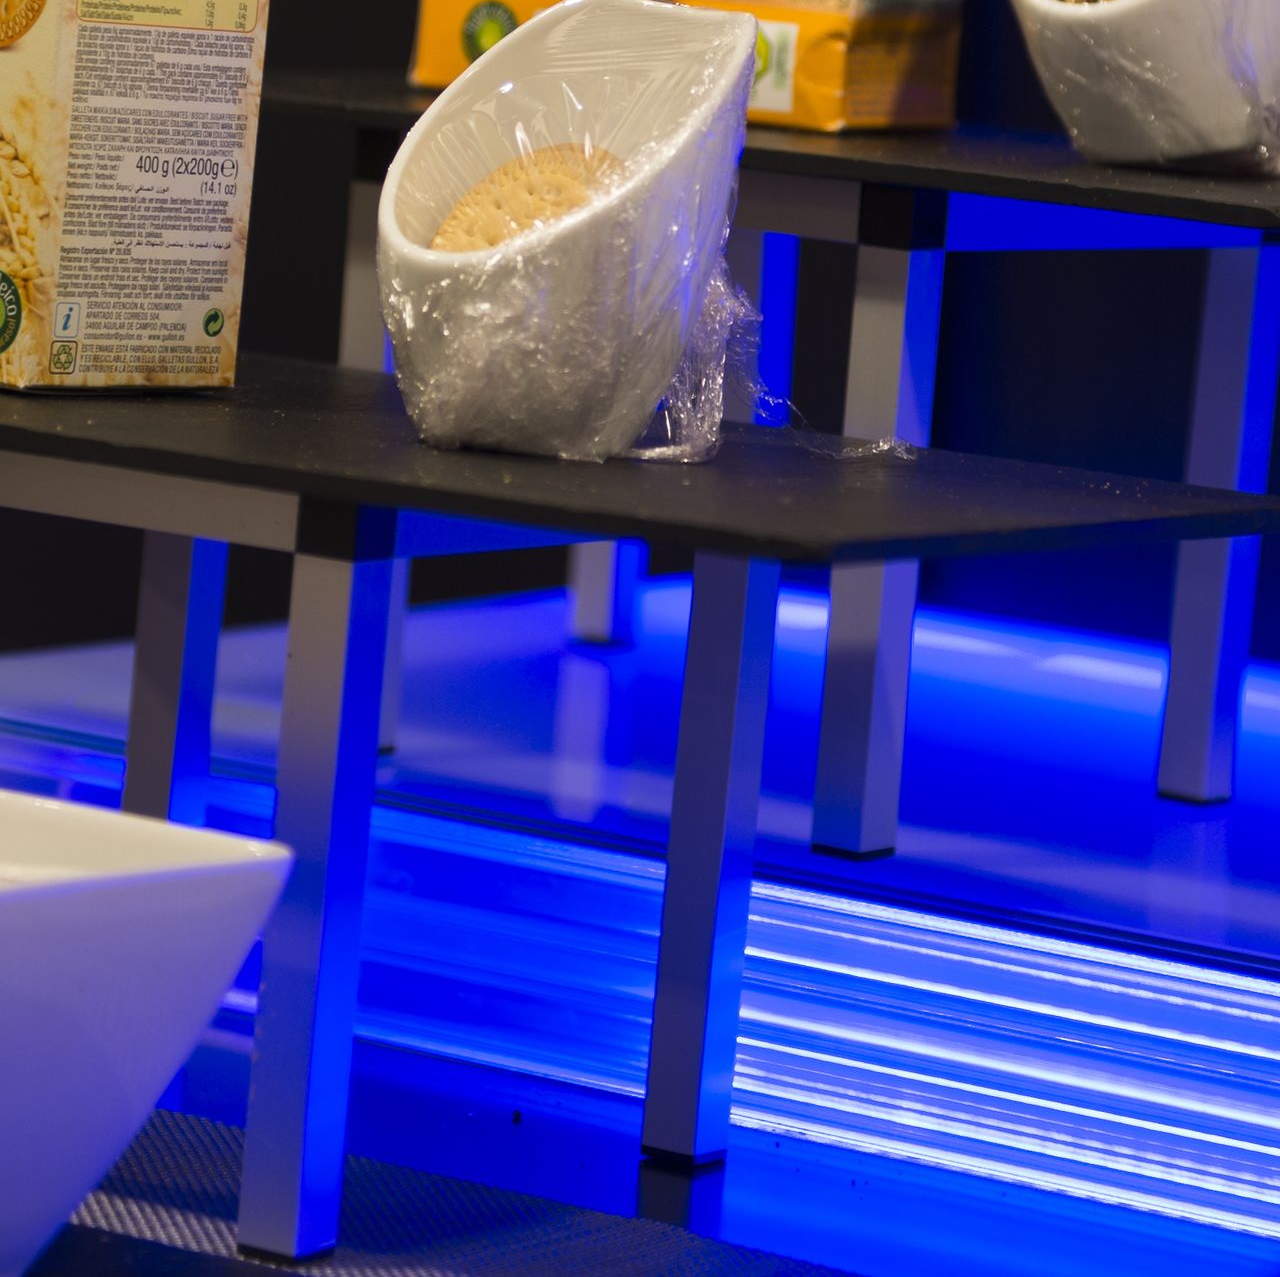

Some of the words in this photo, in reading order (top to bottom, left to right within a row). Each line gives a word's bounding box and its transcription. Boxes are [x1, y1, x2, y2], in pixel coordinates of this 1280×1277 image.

[136, 155, 159, 173] 400
[162, 160, 169, 178] g
[200, 181, 221, 196] (14.1
[224, 182, 237, 199] oz)
